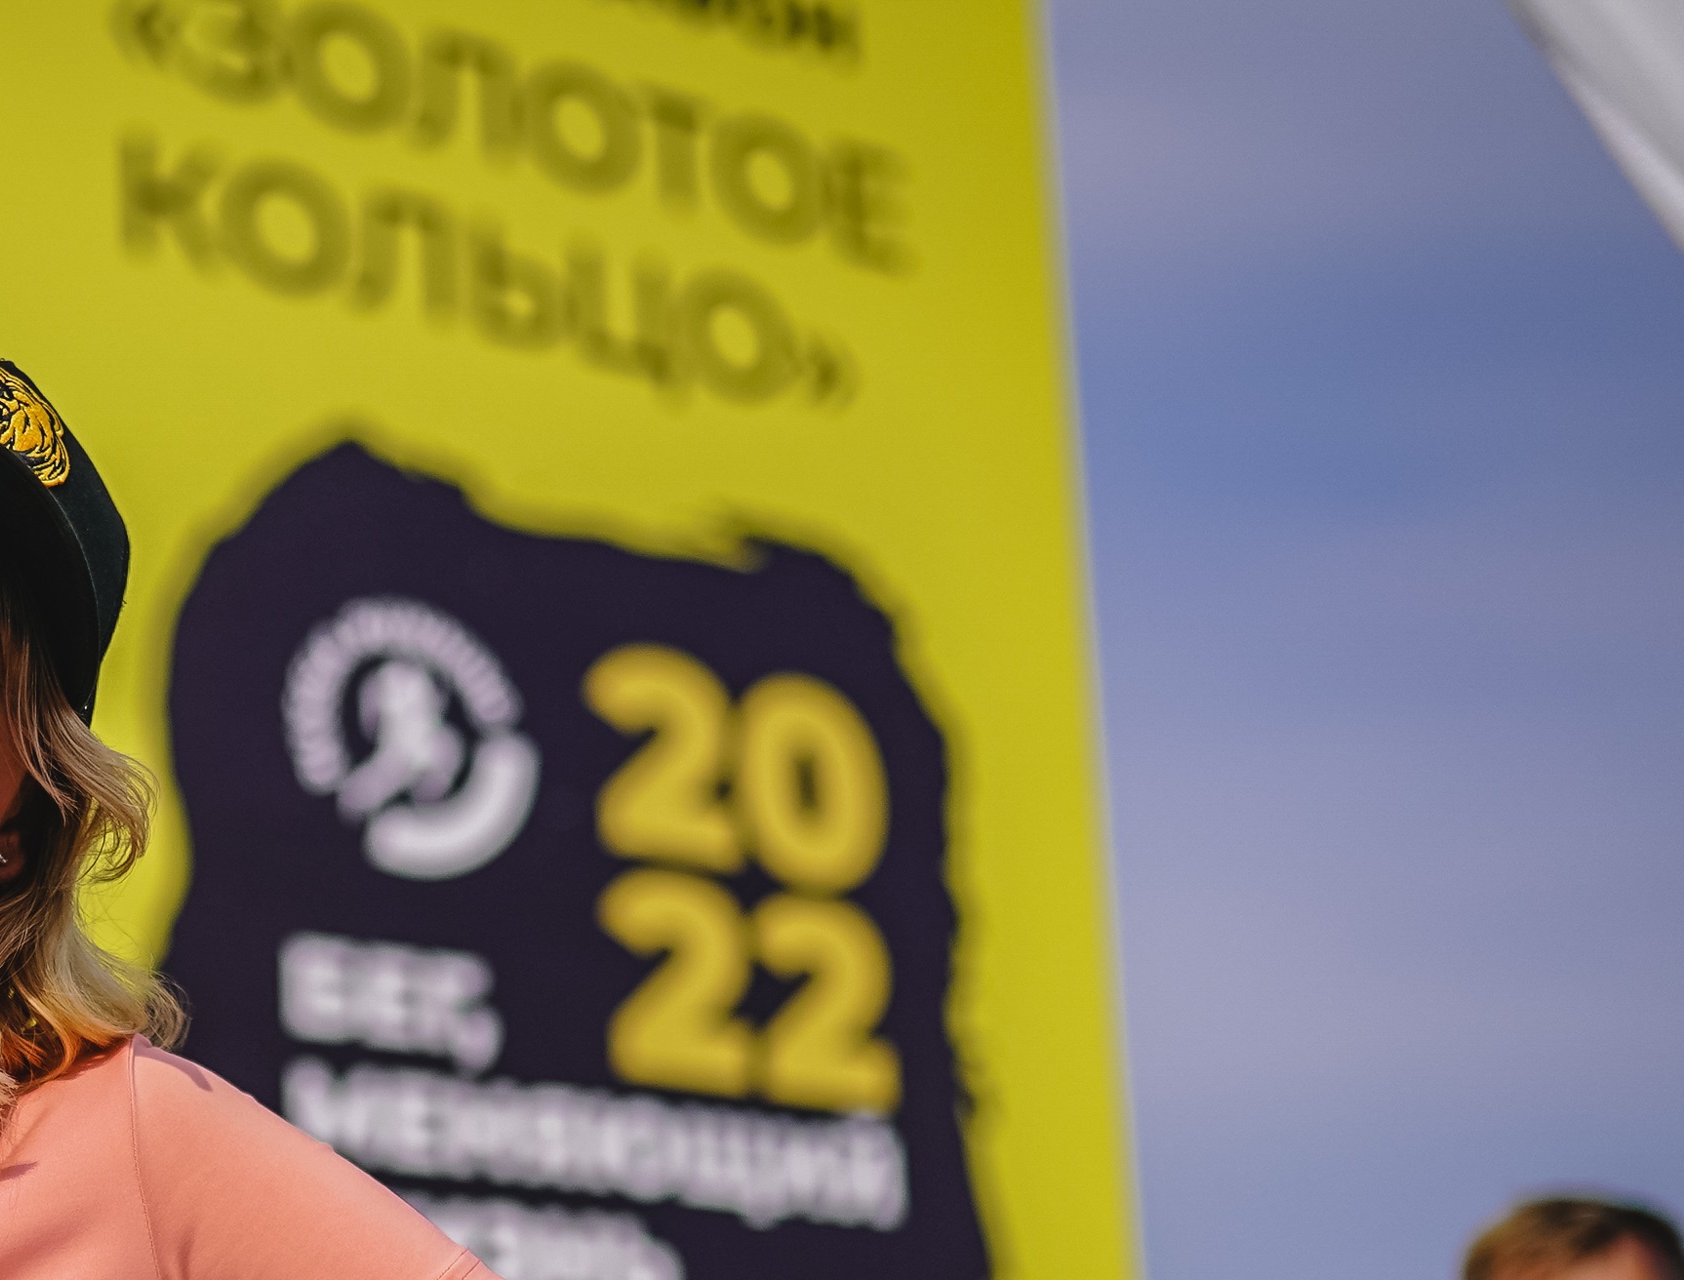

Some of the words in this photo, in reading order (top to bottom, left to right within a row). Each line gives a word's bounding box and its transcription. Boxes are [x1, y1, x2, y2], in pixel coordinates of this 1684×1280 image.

[118, 125, 859, 410] КОЛЬЦО»
[584, 642, 890, 896] 20
[598, 868, 900, 1114] 22
